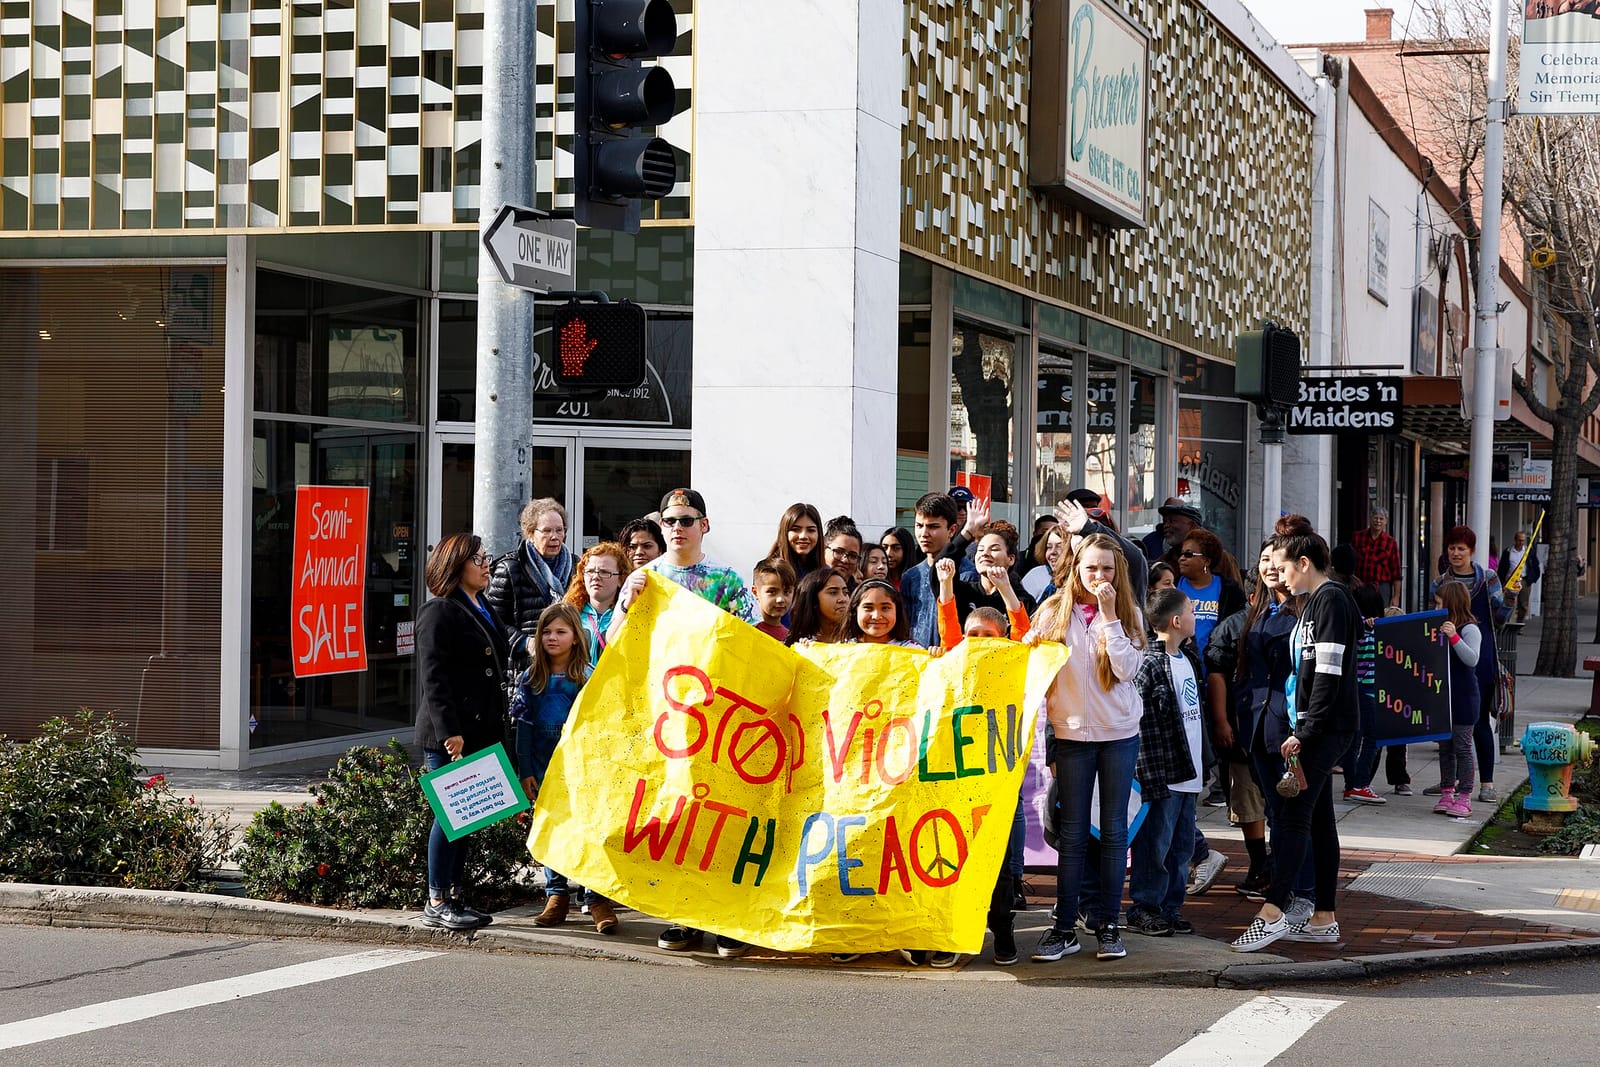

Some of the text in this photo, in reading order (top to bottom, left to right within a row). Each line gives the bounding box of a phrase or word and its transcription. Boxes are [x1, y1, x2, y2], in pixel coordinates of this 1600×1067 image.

[1540, 53, 1600, 66] Celebra
[1529, 90, 1553, 103] Sin
[1088, 143, 1140, 201] SHOE FIT CO.
[518, 232, 569, 270] ONE WAY
[632, 387, 650, 399] 1912
[1298, 380, 1398, 402] Brides 'n
[1290, 405, 1395, 428] Maidens
[309, 497, 353, 540] Semi-
[300, 544, 359, 589] Annual
[299, 603, 360, 664] SALE
[1424, 622, 1444, 647] LET
